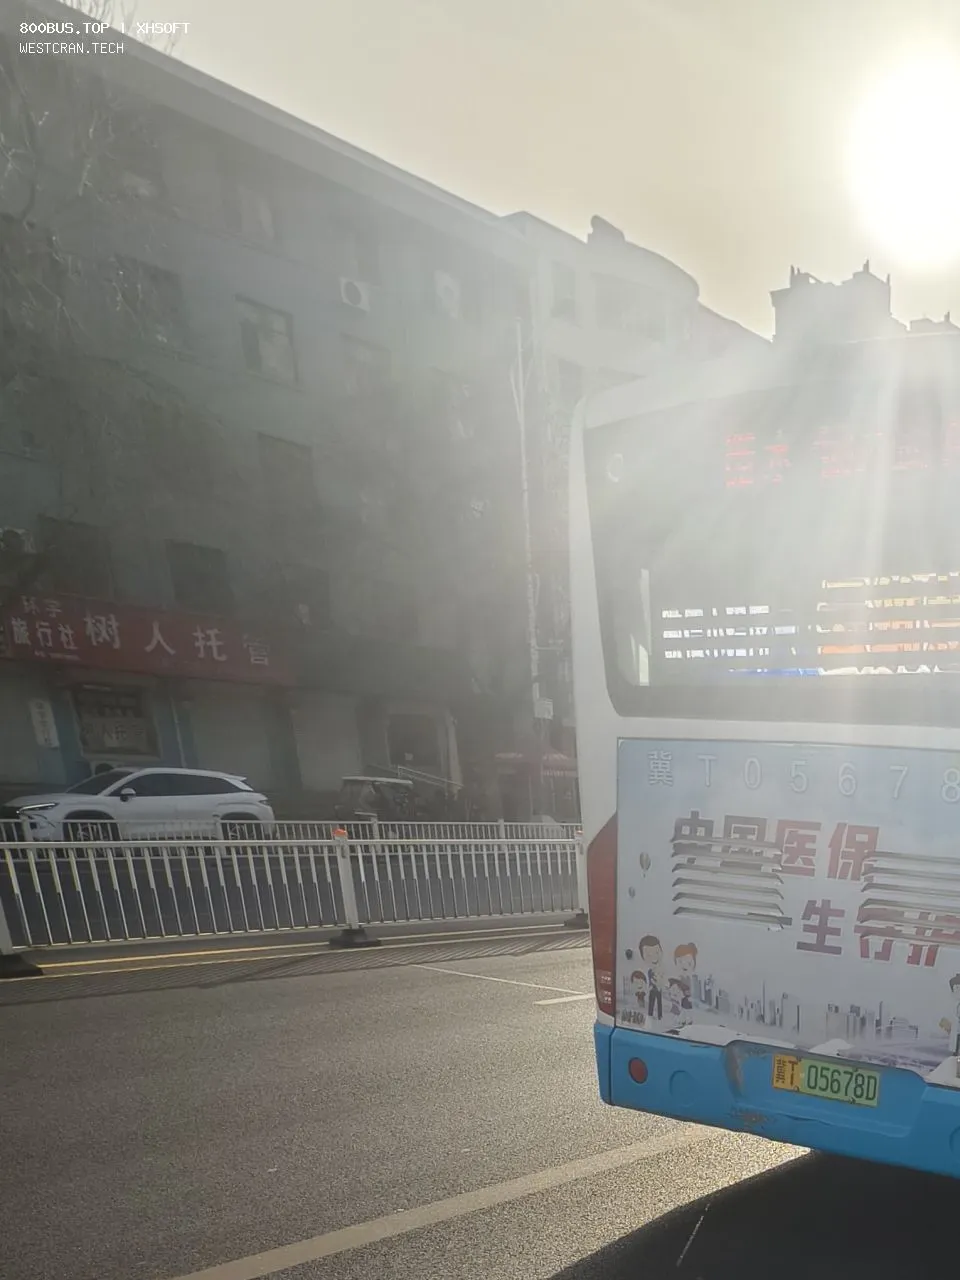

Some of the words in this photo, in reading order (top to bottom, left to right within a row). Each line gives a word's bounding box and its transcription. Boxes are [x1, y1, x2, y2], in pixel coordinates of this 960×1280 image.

[83, 610, 271, 666] 树人托管
[670, 810, 880, 882] 中国医保
